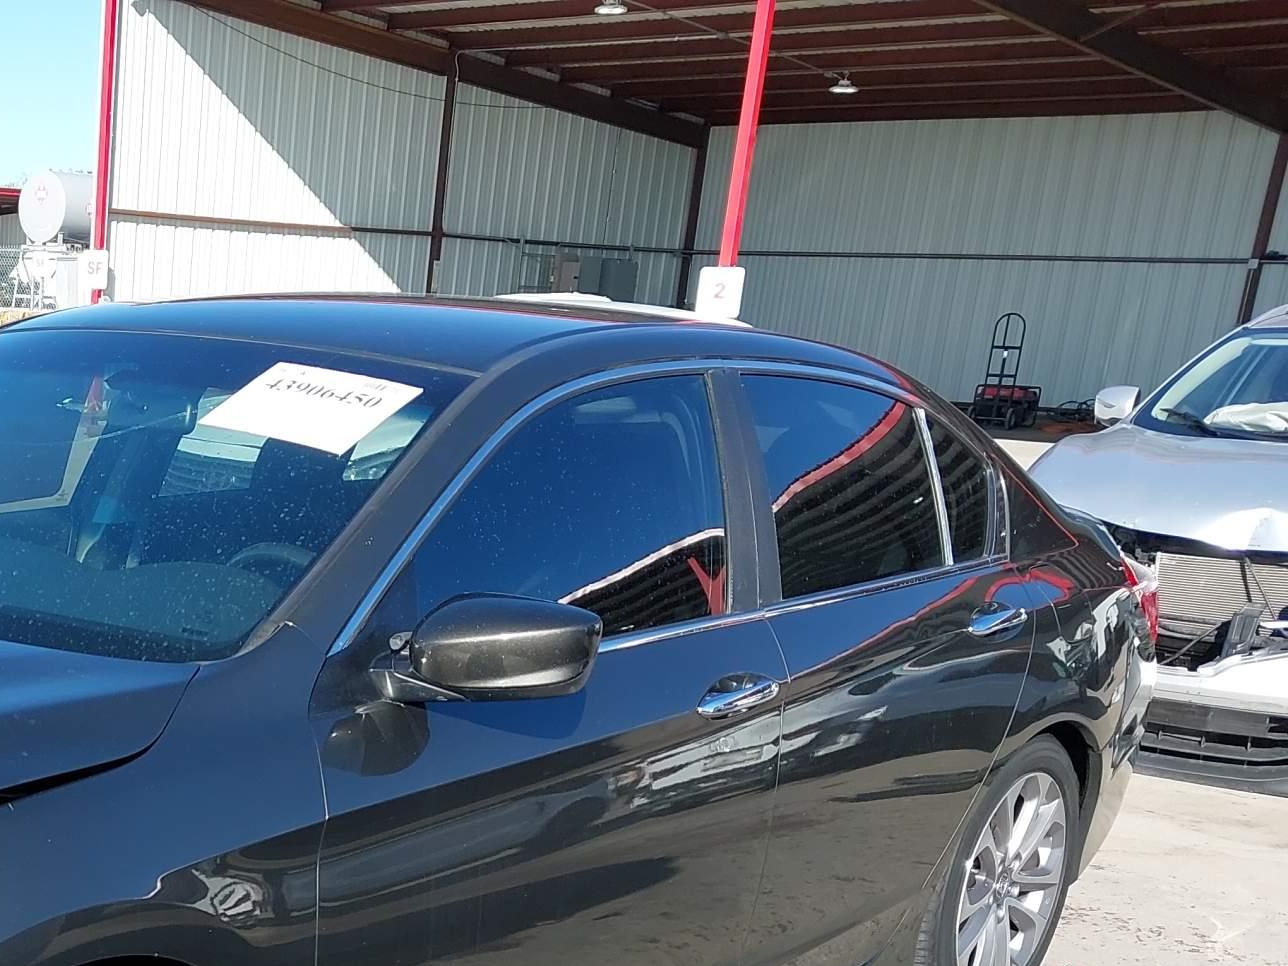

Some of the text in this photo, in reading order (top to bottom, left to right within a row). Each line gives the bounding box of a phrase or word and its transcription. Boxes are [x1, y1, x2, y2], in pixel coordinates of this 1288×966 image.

[88, 262, 104, 275] SF
[713, 282, 726, 299] 2
[265, 378, 383, 408] 43906450
